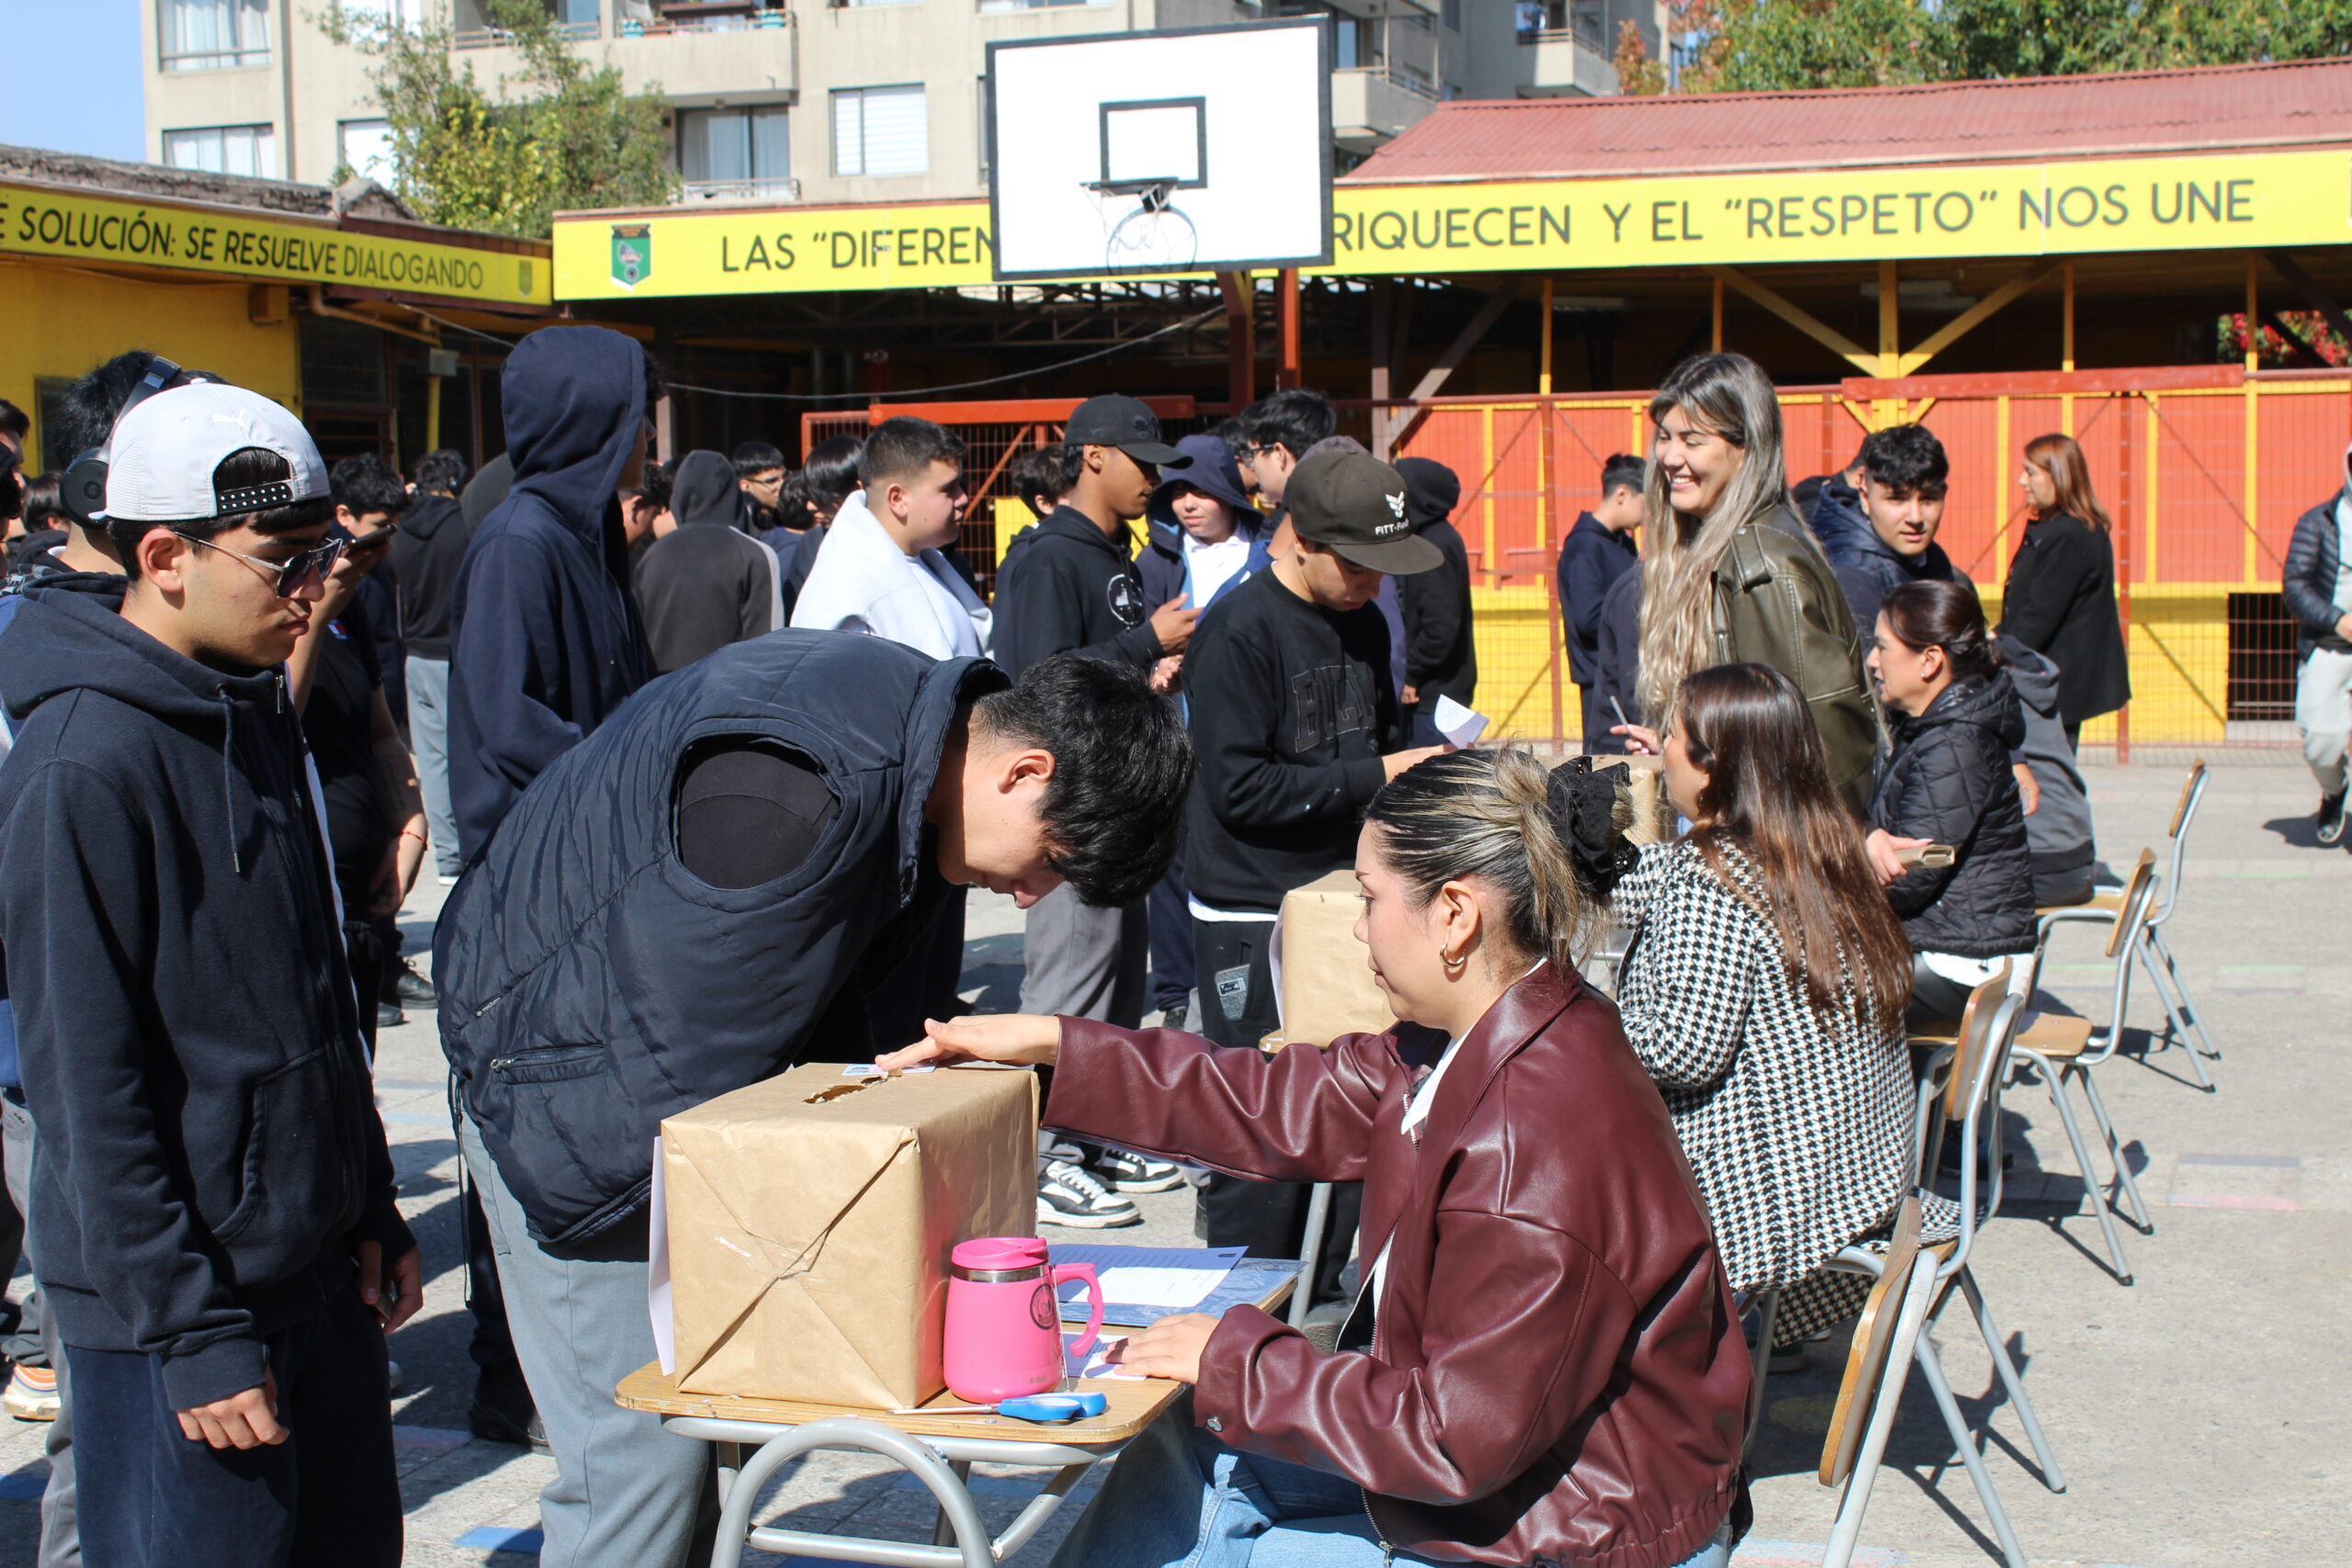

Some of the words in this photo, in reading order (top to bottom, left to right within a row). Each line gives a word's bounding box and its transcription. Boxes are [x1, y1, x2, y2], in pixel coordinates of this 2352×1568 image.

[17, 205, 176, 255] SOLUCIÓN:
[185, 225, 217, 261] SE
[224, 230, 337, 275] RESUELVE
[343, 245, 484, 290] DIALOGANDO
[721, 231, 796, 273] LAS
[1601, 202, 1633, 243] Y
[1651, 199, 1705, 243] EL
[1724, 189, 1998, 239] "RESPETO"
[2018, 183, 2131, 231] NOS
[2151, 177, 2256, 225] UNE
